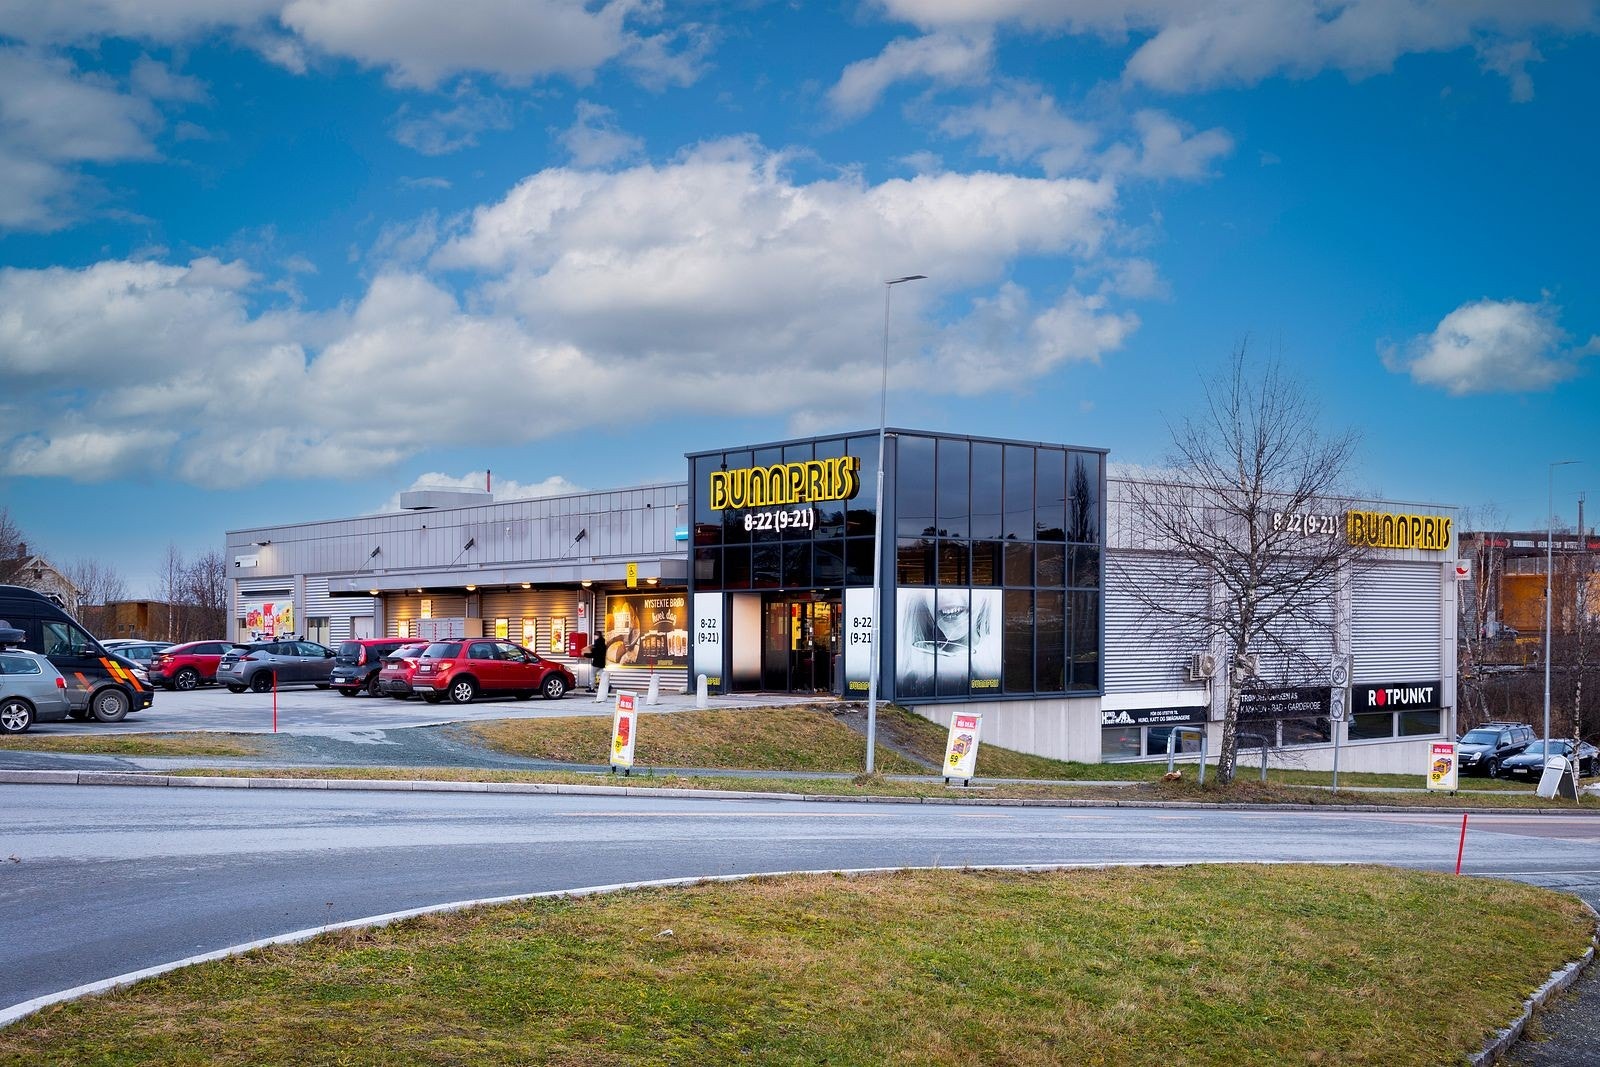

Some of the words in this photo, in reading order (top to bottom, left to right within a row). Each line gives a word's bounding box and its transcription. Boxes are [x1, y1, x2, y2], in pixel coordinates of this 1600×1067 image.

[710, 456, 860, 510] BUNNPRIS
[744, 510, 773, 531] 8-22
[775, 507, 815, 532] (9-21)
[1303, 513, 1340, 538] (9-21)
[1346, 510, 1452, 551] BUNNPRIS
[644, 598, 669, 608] NYSTEKTE
[700, 618, 717, 628] 8-22
[853, 617, 872, 628] 8-22
[698, 632, 719, 645] (9-21)
[850, 632, 872, 646] (9-21
